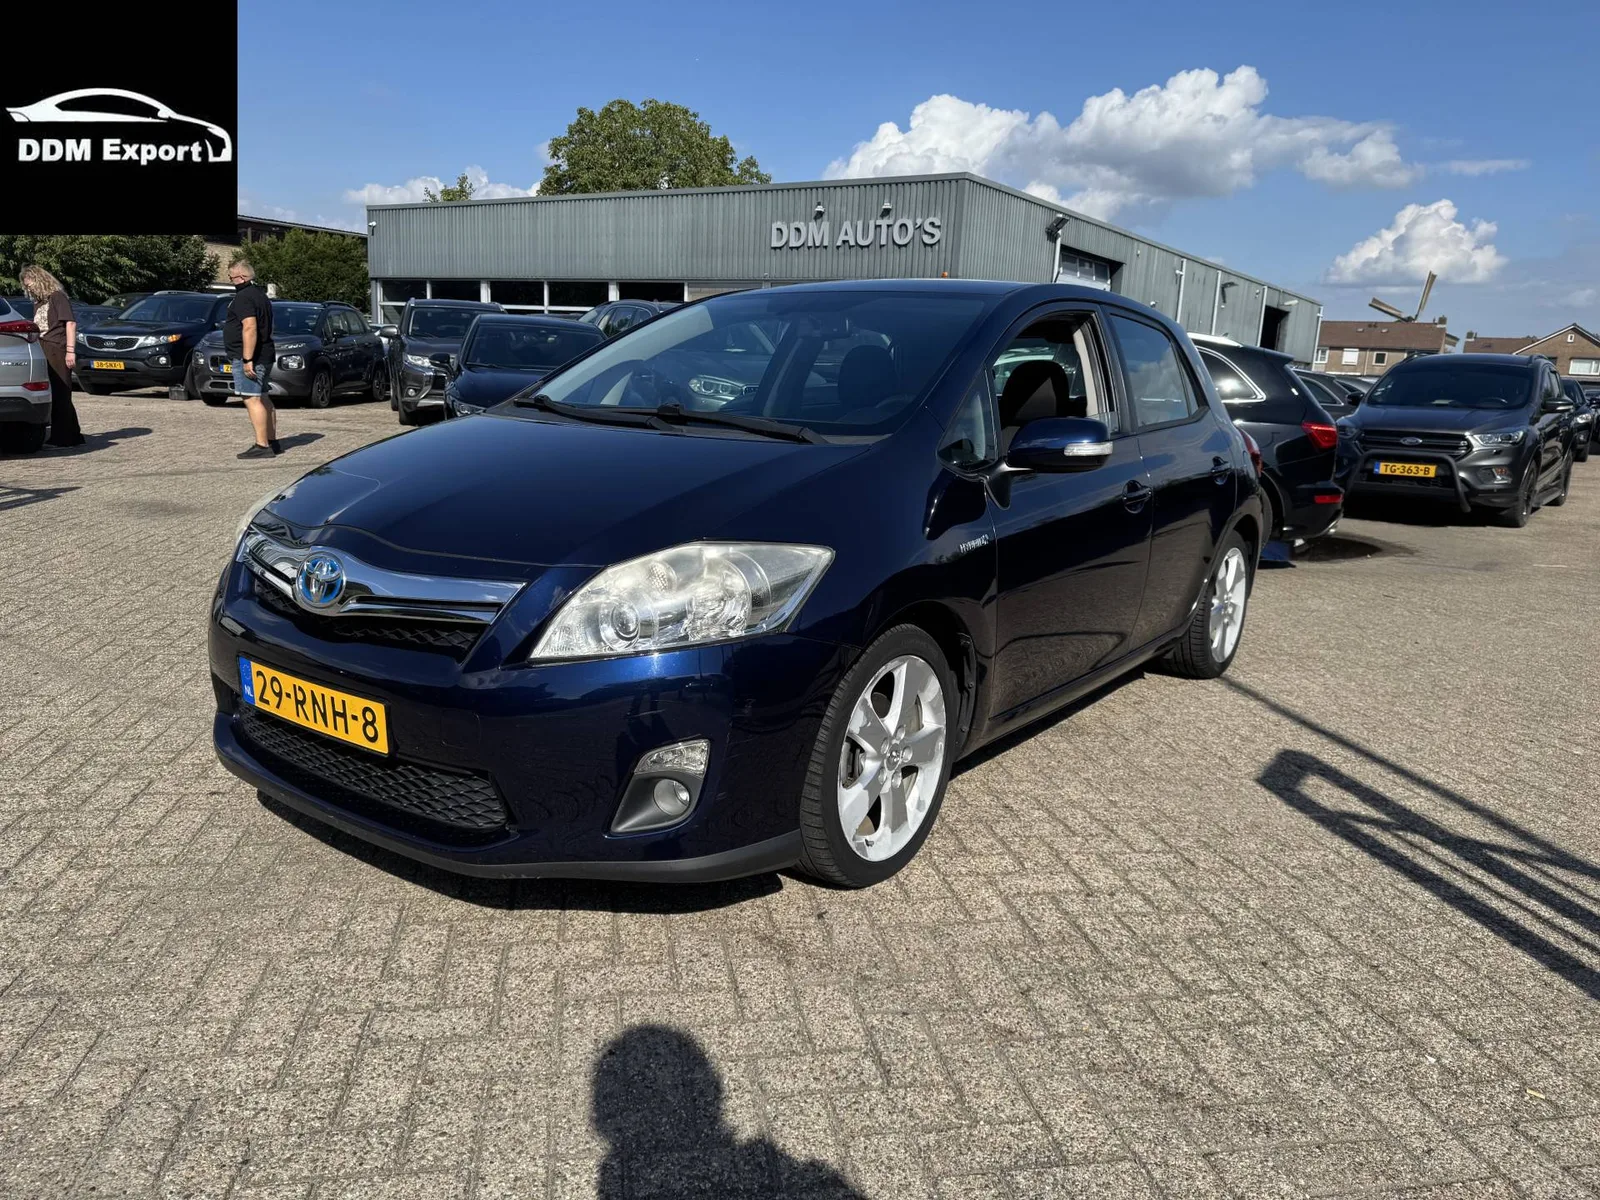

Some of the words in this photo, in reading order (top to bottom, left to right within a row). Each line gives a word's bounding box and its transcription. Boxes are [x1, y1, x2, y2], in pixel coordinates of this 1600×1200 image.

[770, 220, 829, 249] DDM
[835, 216, 942, 247] AUTO'S
[1383, 464, 1431, 476] TG-363-B
[256, 670, 379, 744] 29-RNH-8
